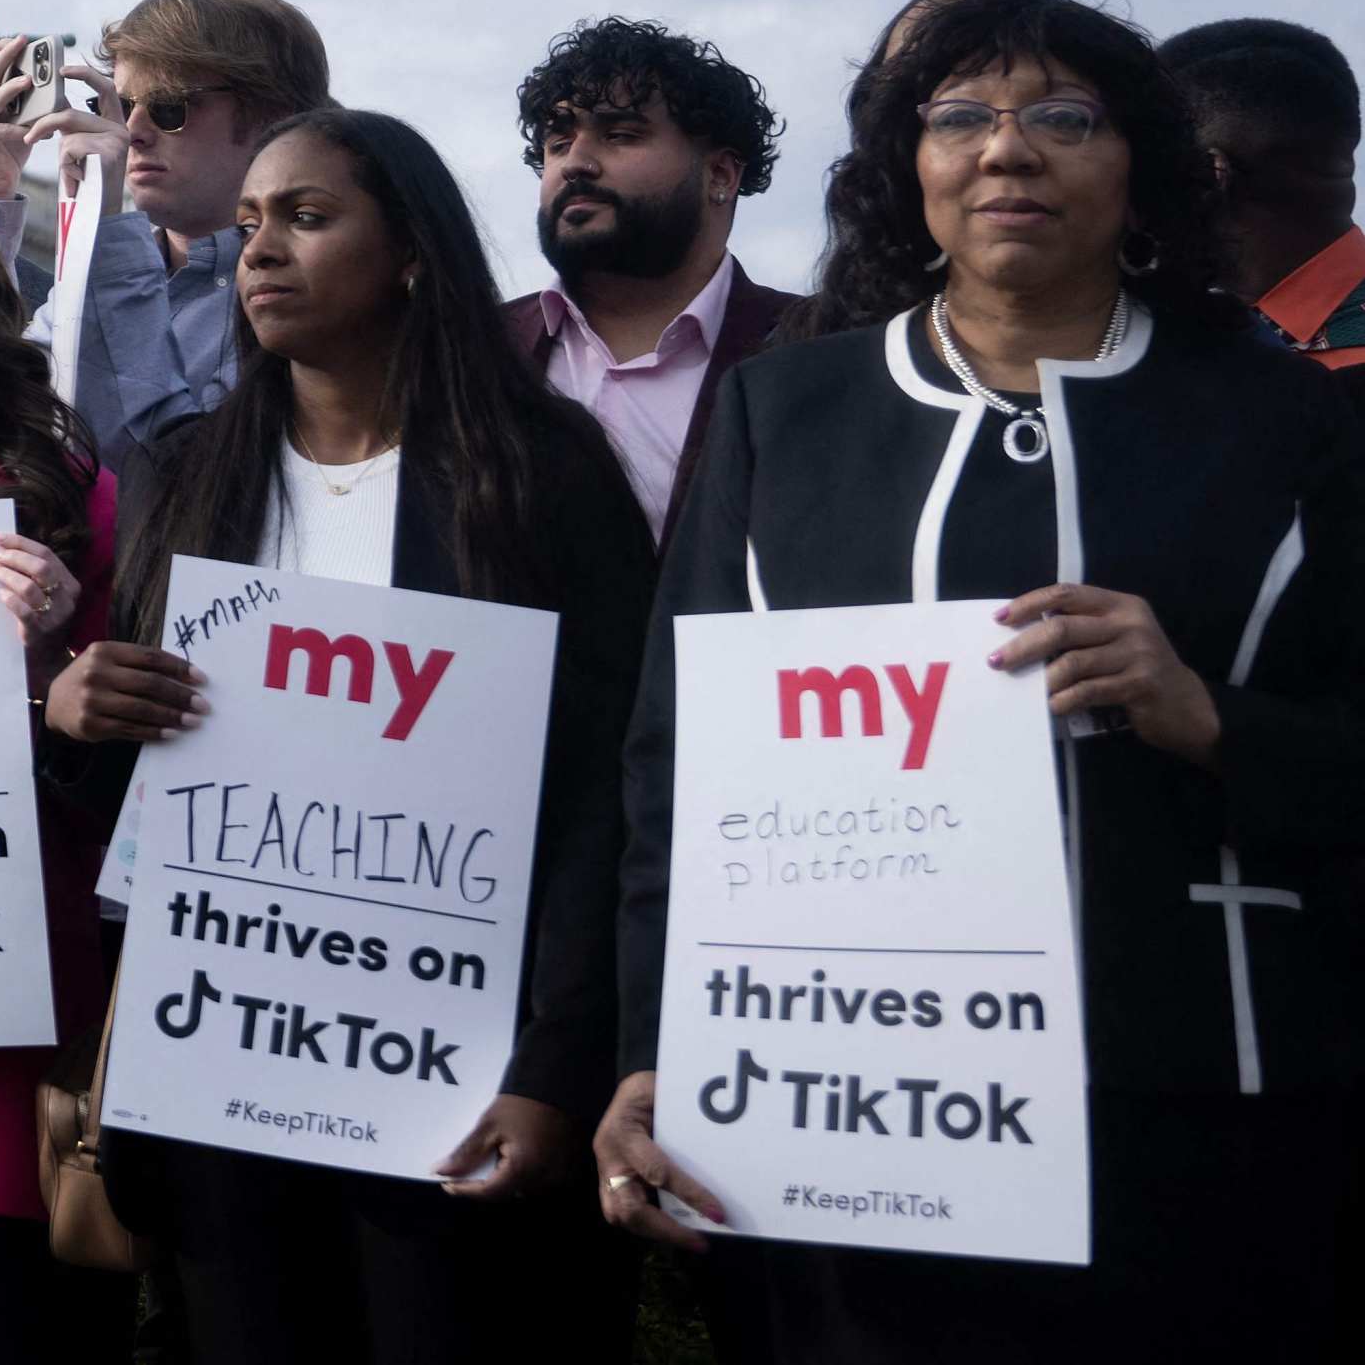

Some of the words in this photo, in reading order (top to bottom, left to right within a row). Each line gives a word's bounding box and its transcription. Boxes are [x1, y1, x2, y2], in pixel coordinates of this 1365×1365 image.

[263, 623, 456, 741] my
[776, 661, 951, 770] my
[165, 782, 498, 904] TEACHING
[716, 796, 962, 843] education
[723, 843, 941, 901] platform
[167, 890, 389, 973] thrives
[408, 944, 486, 990] on
[704, 964, 943, 1029] thrives
[964, 989, 1046, 1031] on
[231, 992, 463, 1086] TikTok
[224, 1097, 379, 1144] #KeepTikTok
[780, 1068, 1034, 1146] TikTok
[781, 1184, 953, 1221] #KeepTikTok
